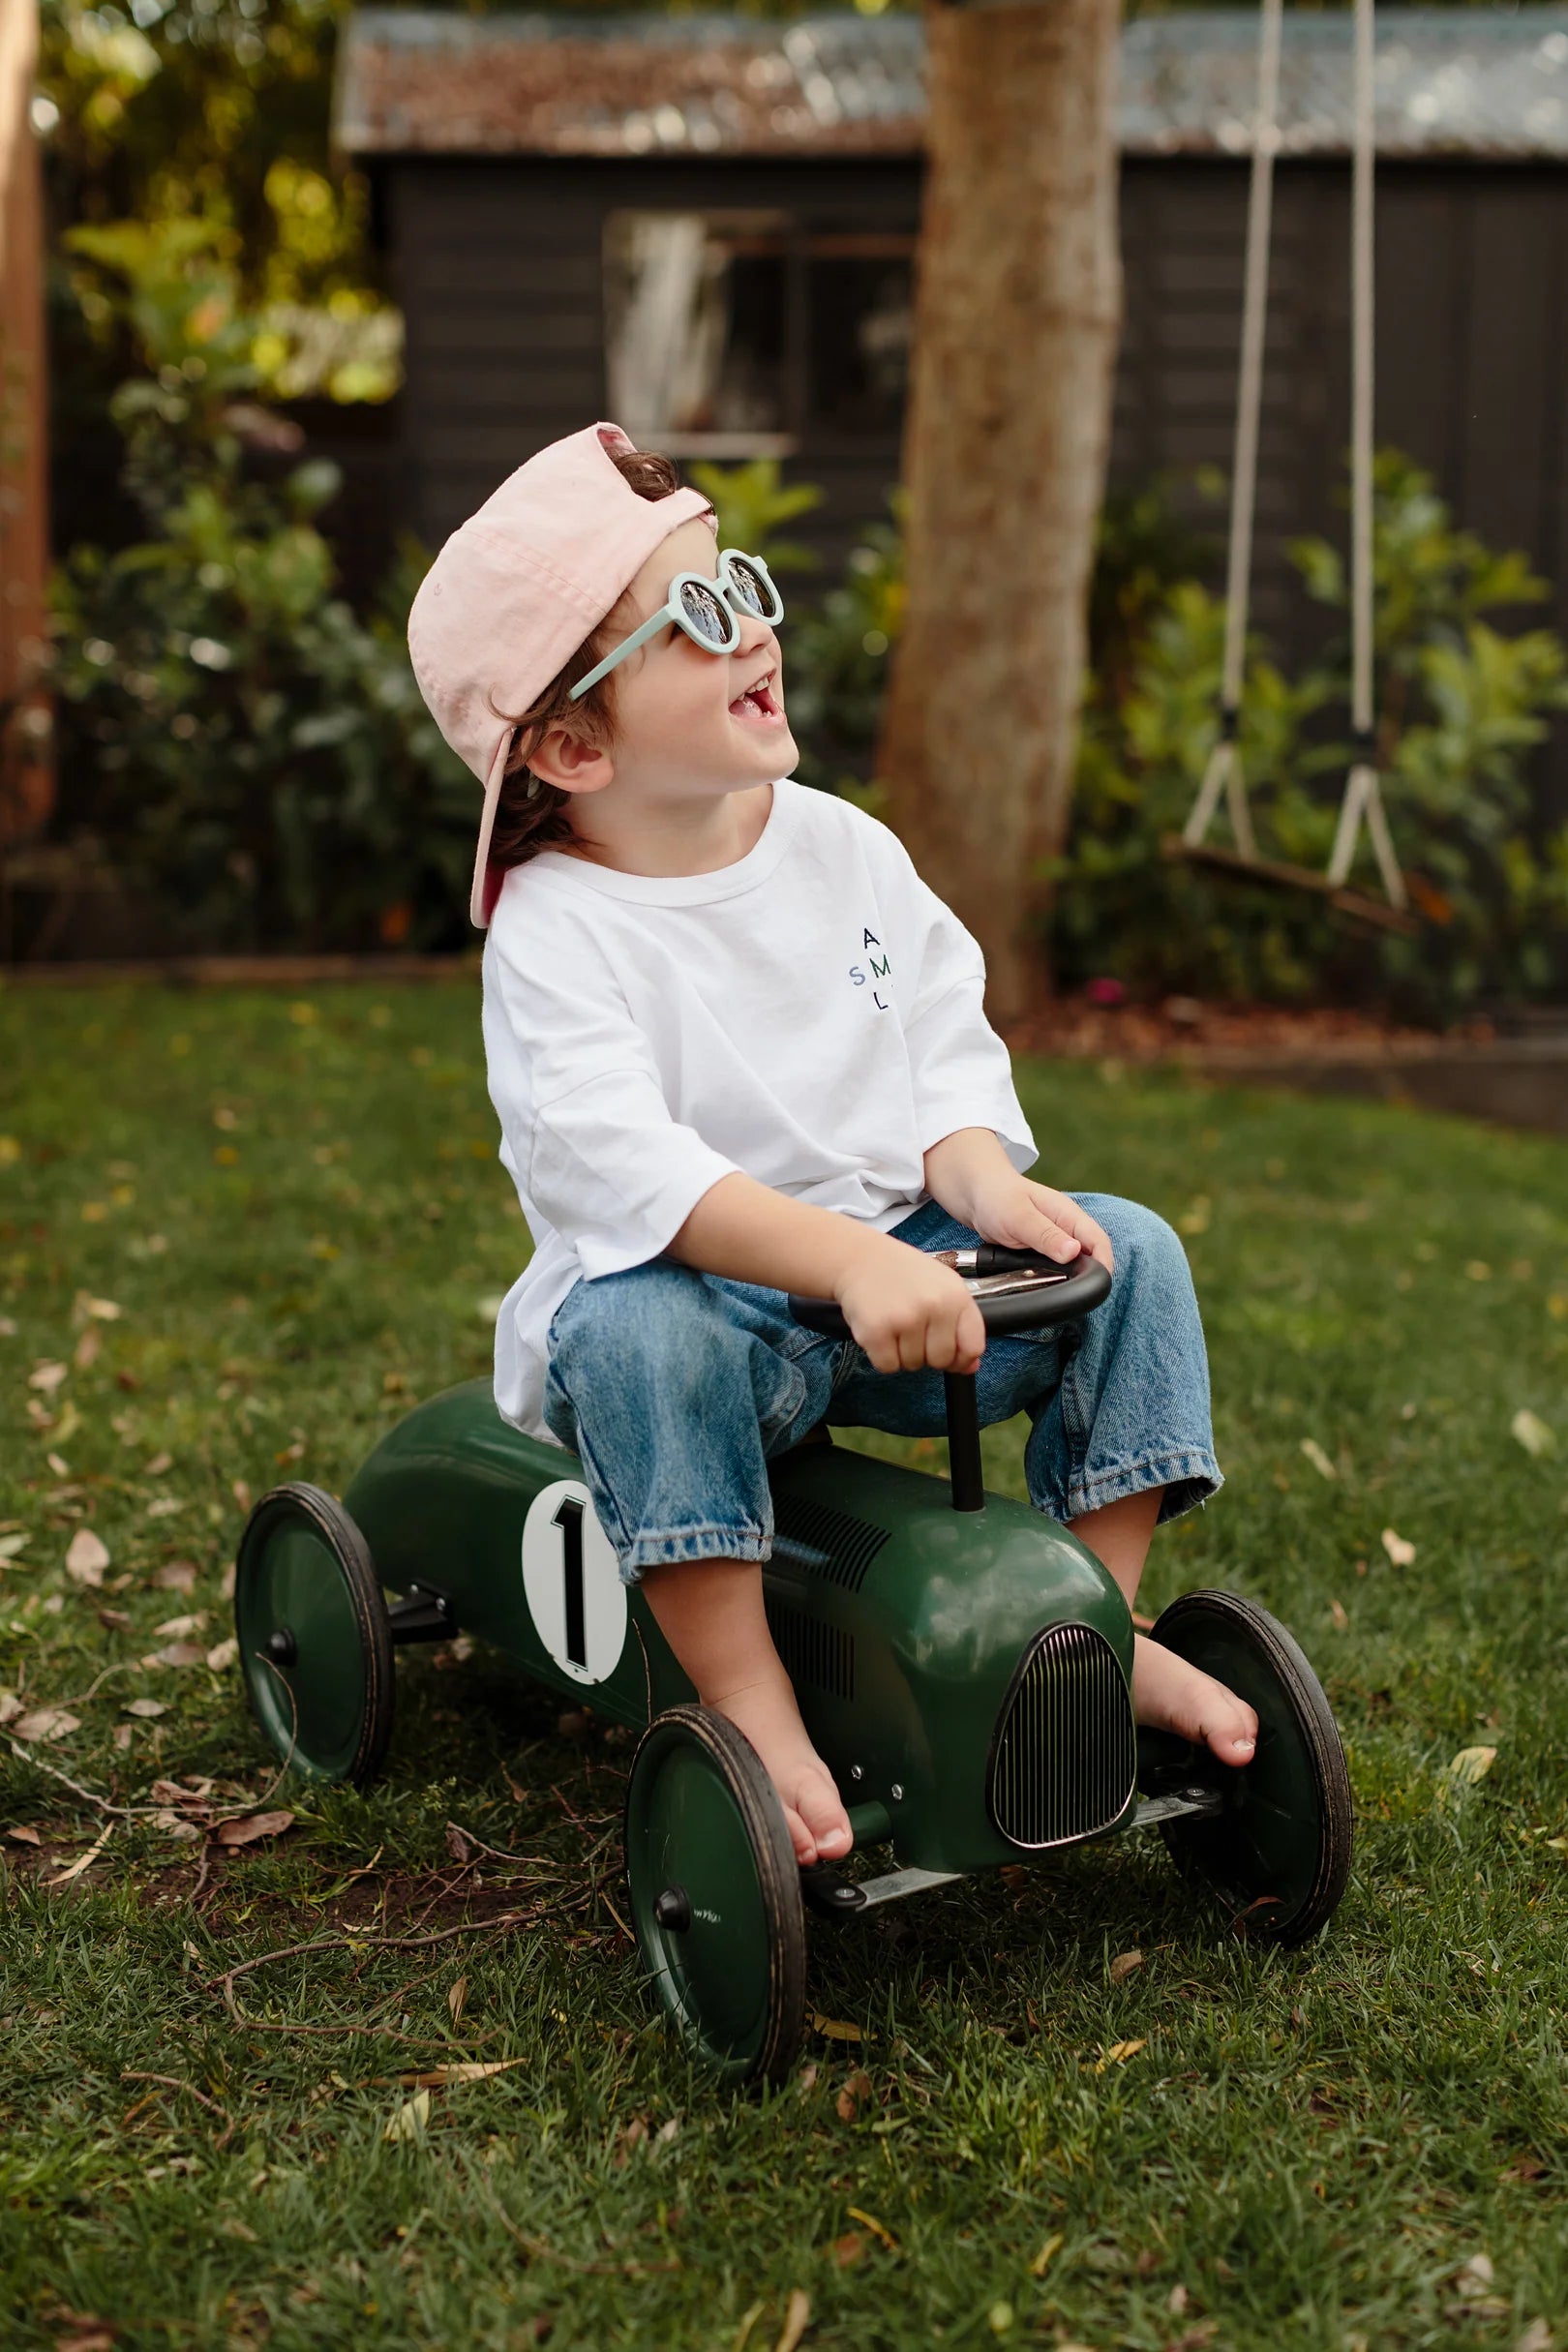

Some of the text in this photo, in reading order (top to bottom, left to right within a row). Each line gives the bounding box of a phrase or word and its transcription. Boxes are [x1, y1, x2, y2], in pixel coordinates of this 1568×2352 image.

[863, 927, 881, 950] A
[873, 991, 889, 1010] L
[550, 1493, 588, 1672] 1
